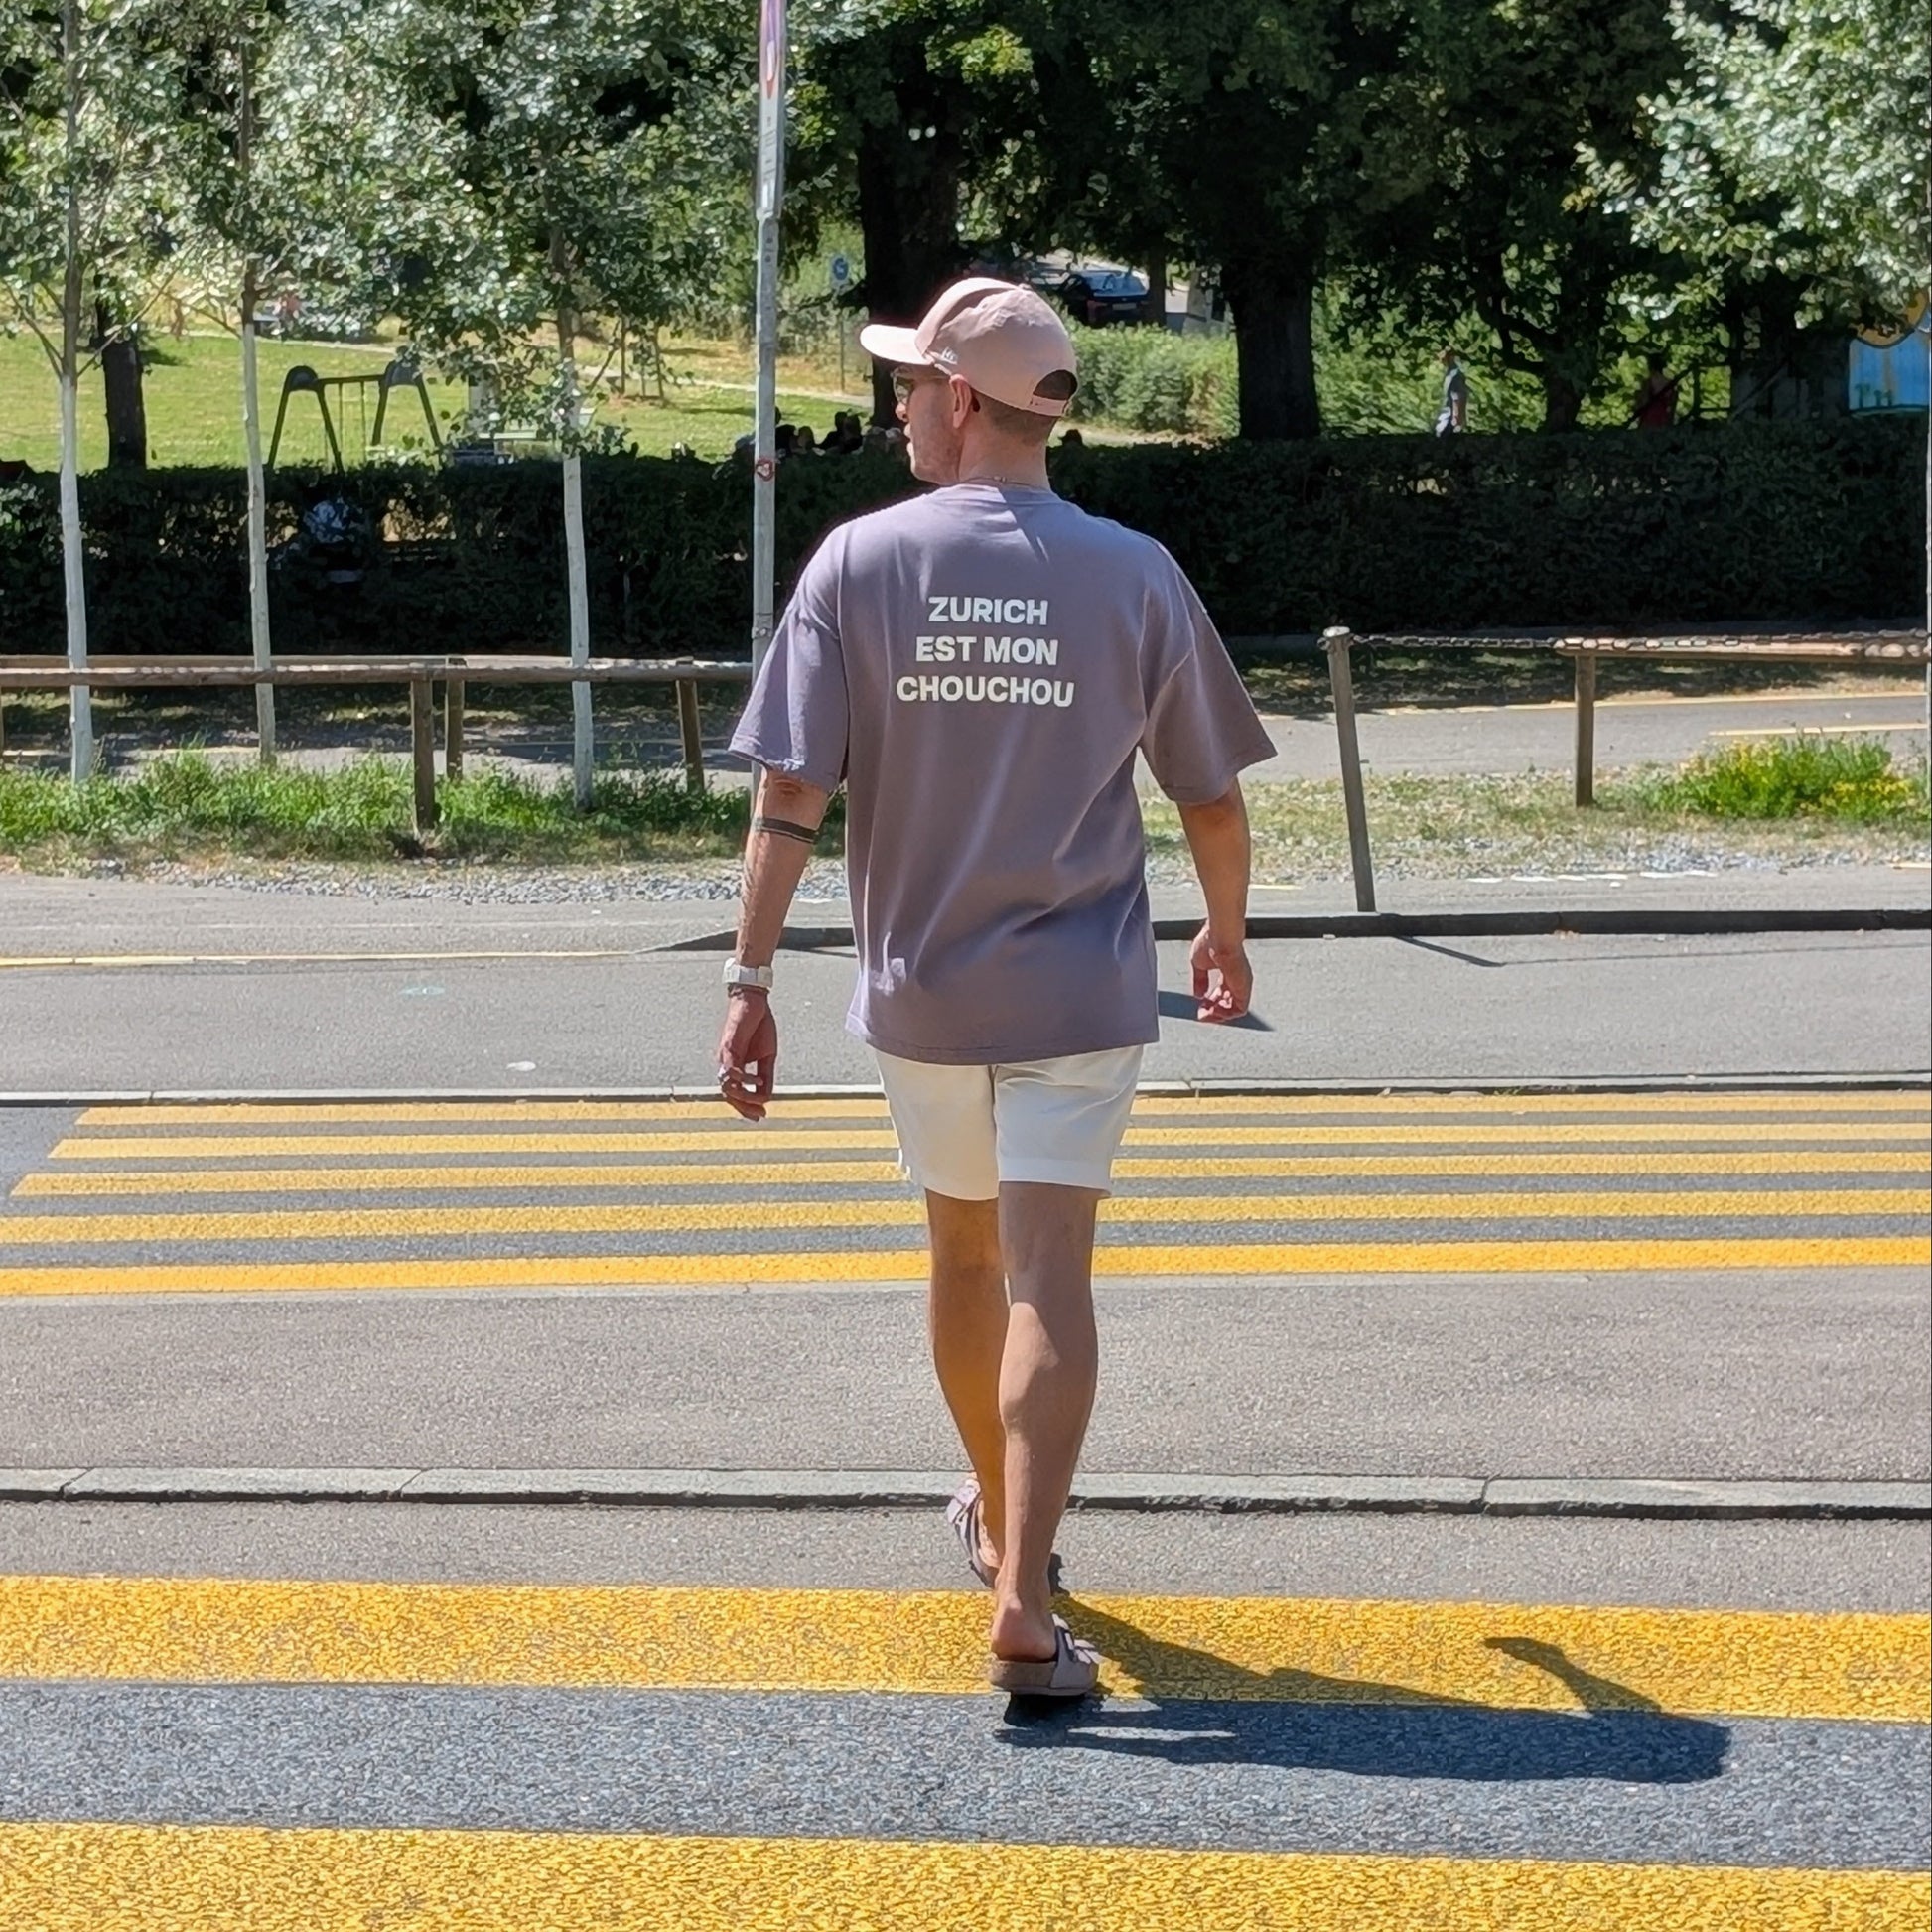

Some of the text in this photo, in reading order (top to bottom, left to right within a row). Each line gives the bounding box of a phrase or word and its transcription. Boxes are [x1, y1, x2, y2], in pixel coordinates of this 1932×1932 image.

[928, 596, 1048, 625] ZURICH
[915, 636, 1059, 666] EST MON
[896, 675, 1075, 708] CHOUCHOU
